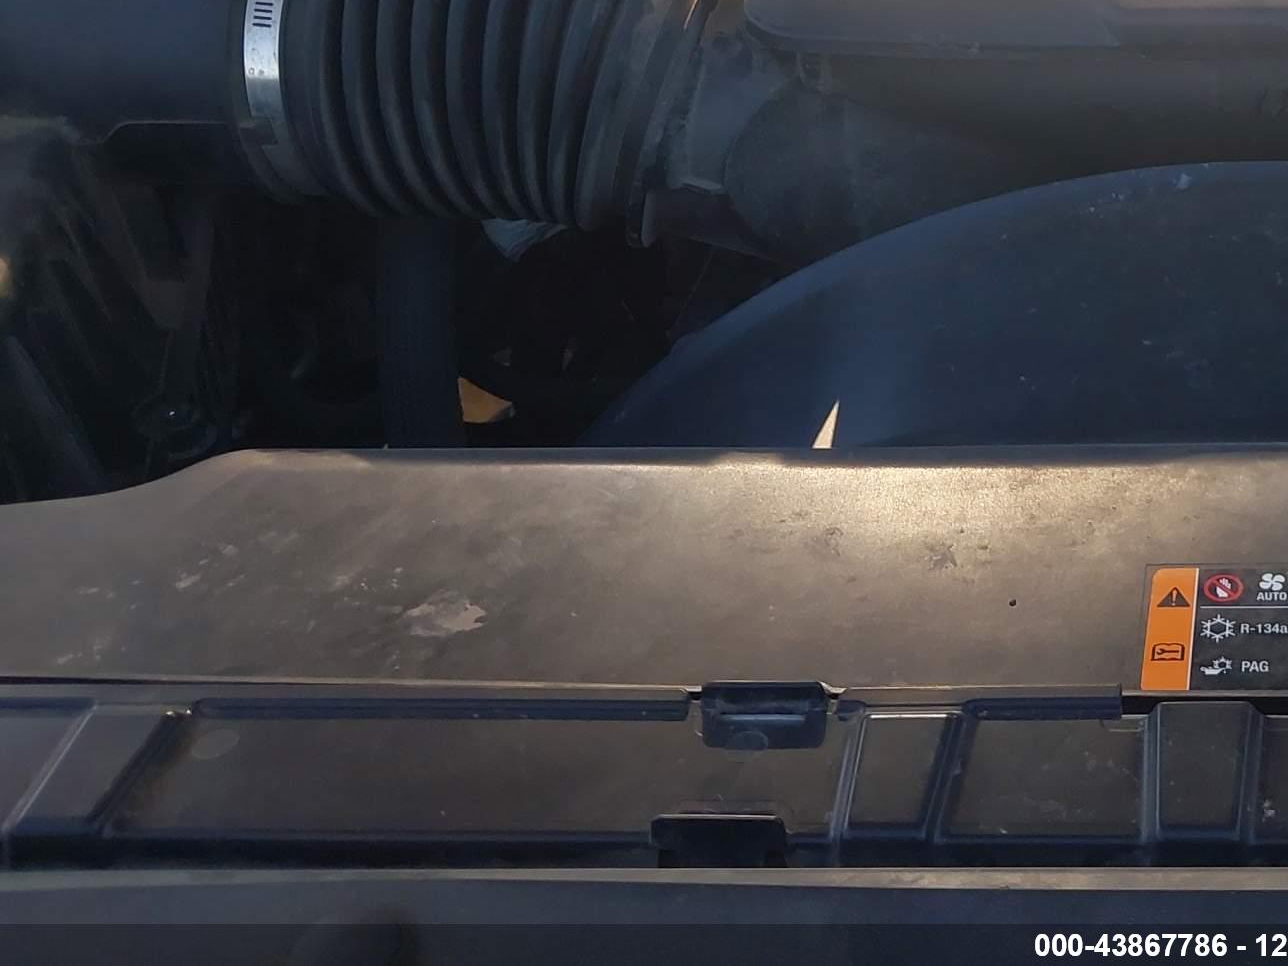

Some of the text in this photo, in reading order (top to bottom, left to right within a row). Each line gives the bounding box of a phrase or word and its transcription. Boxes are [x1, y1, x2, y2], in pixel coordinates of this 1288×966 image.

[1256, 591, 1287, 601] AUTO
[1240, 622, 1288, 633] R-134a
[1241, 660, 1269, 672] PAG
